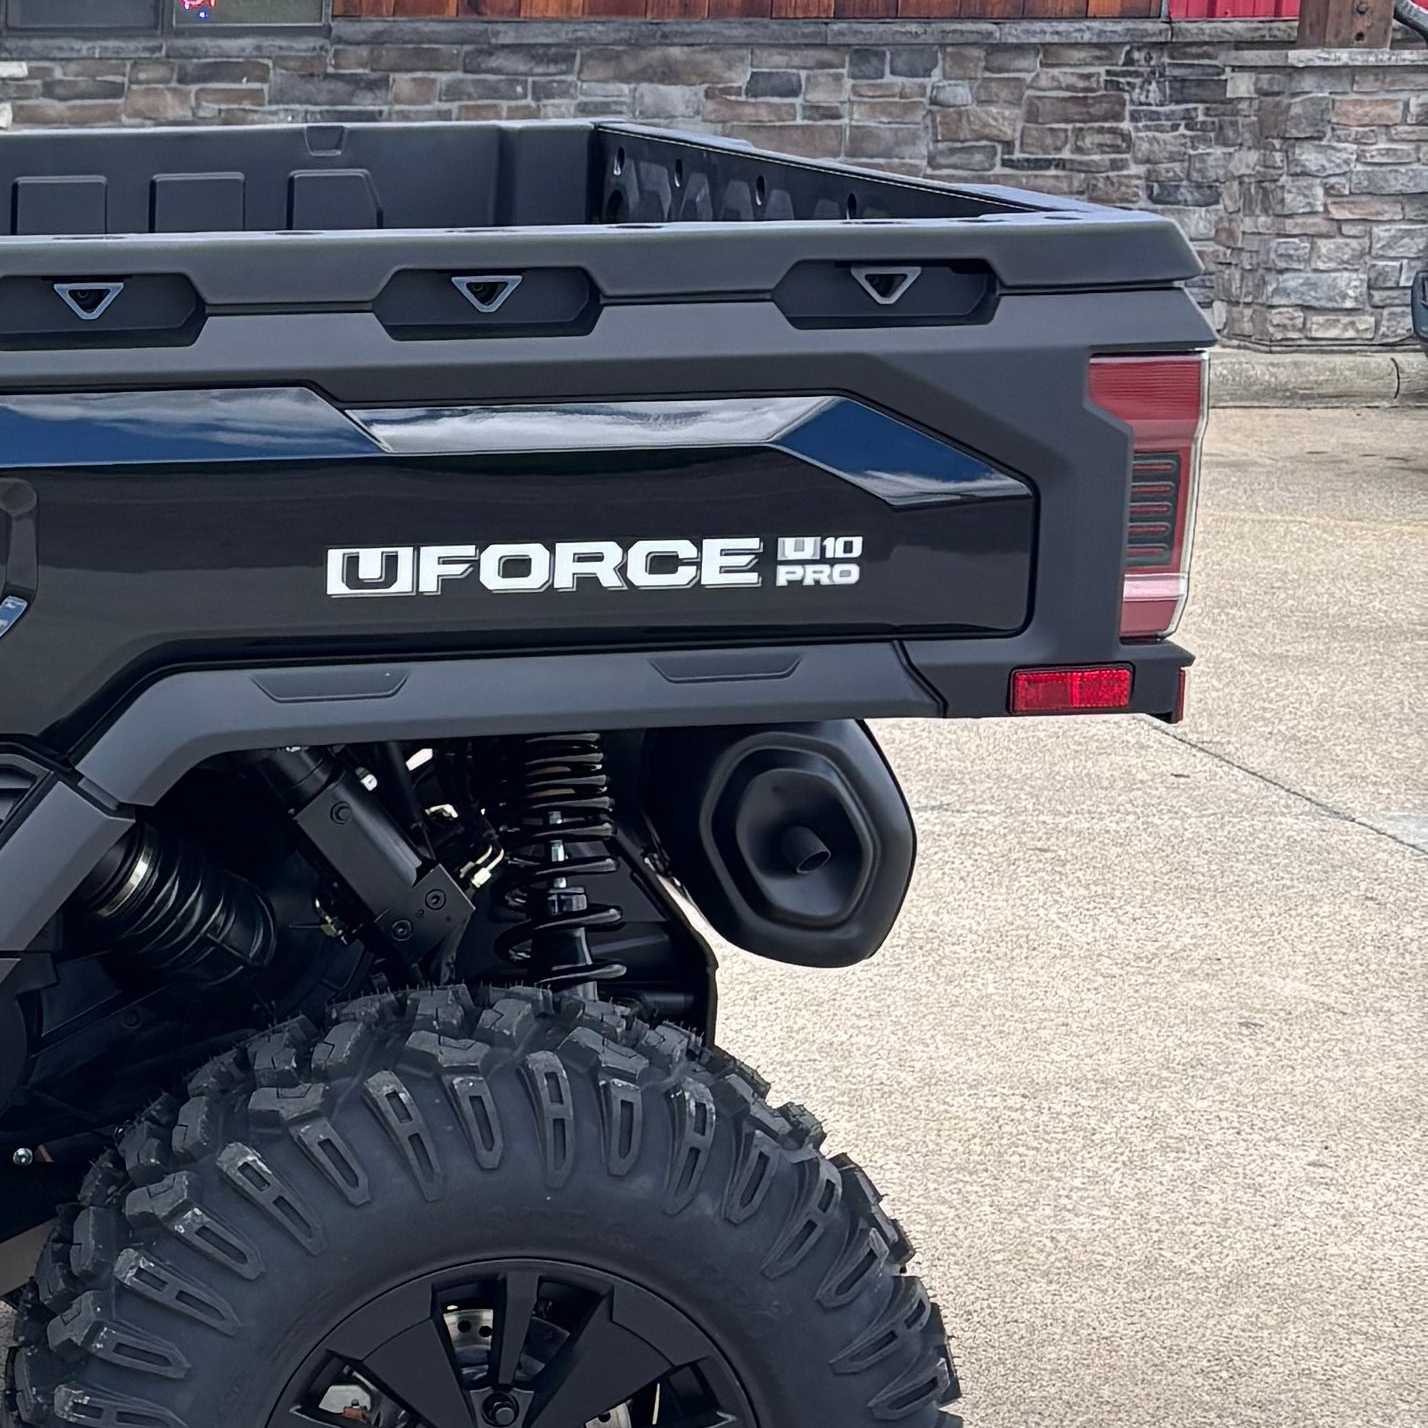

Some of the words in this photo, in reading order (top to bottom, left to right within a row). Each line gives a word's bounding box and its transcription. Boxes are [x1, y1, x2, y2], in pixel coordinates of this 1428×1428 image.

[776, 536, 863, 560] U10
[326, 537, 763, 598] UFORCE
[776, 563, 861, 587] PRO
